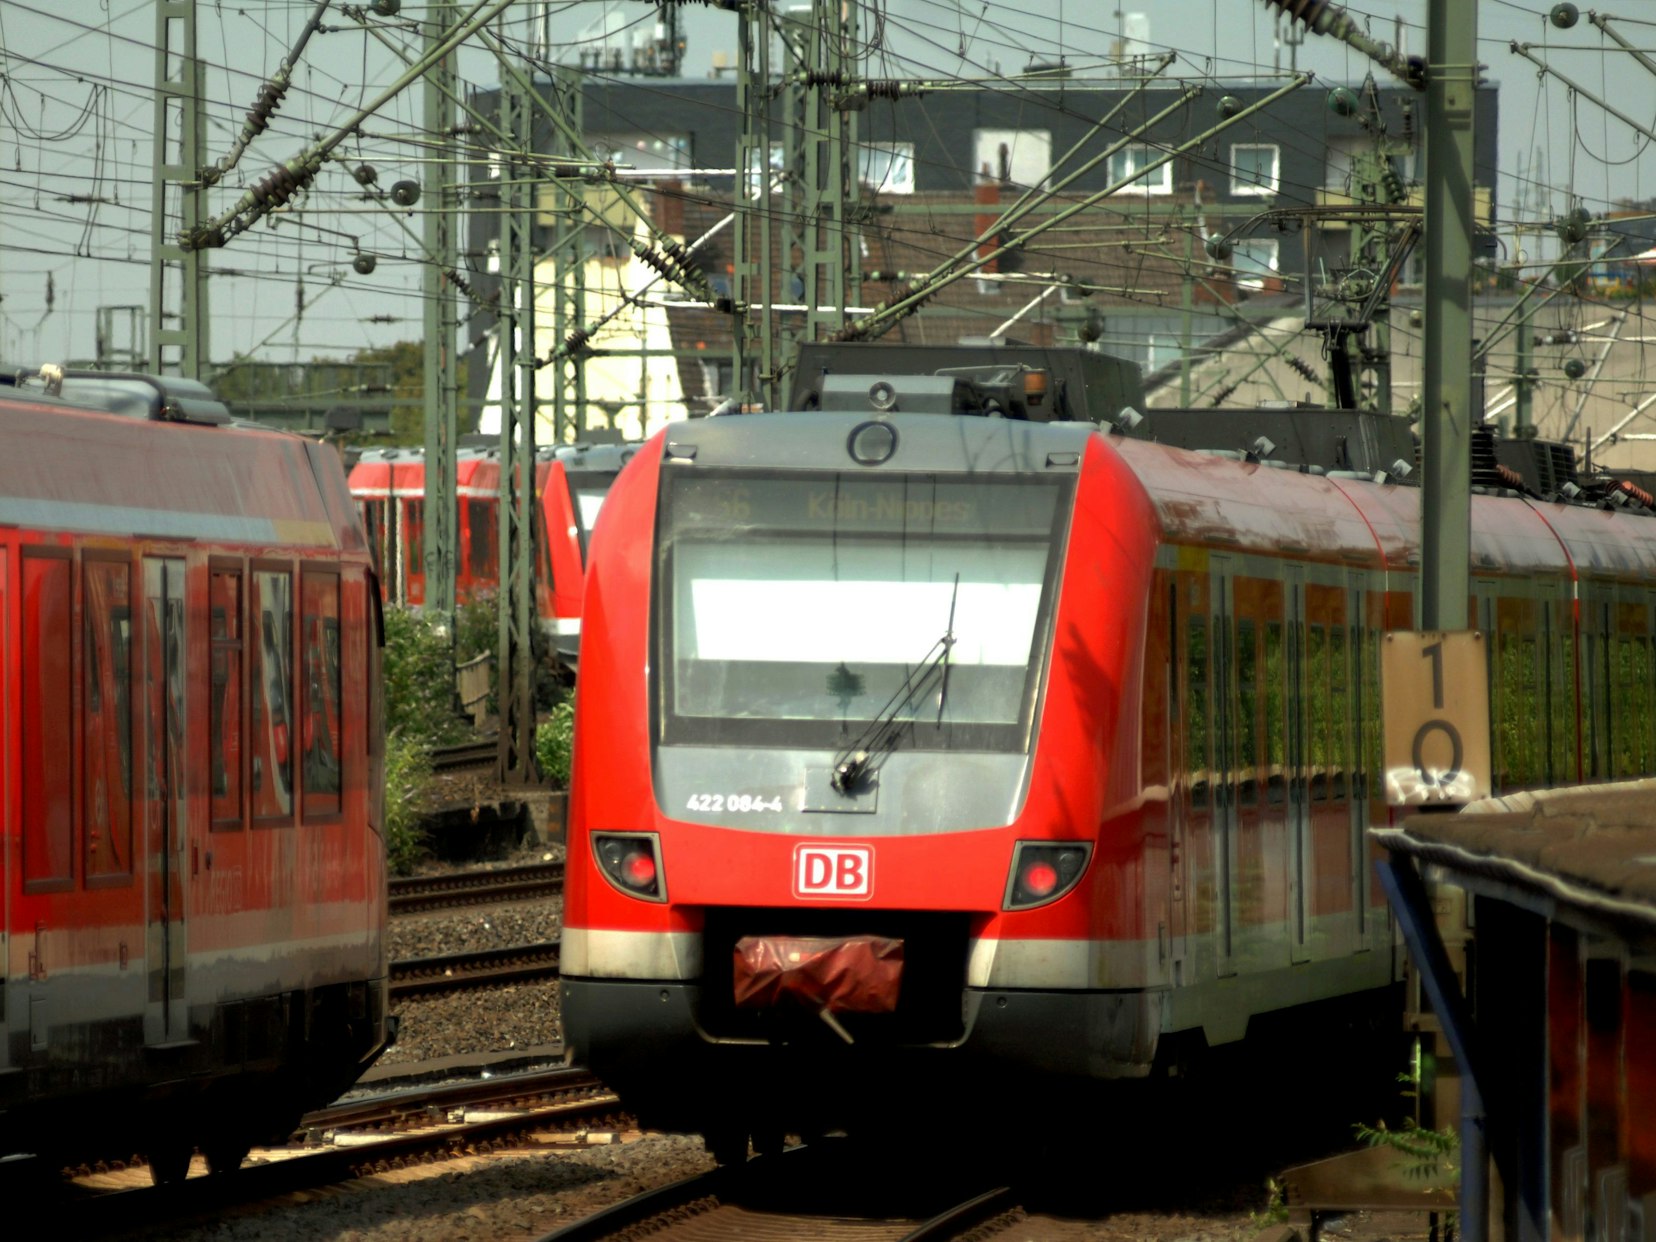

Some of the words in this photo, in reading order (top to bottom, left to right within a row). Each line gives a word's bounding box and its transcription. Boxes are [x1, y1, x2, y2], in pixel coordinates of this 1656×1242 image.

[686, 793, 724, 812] 422
[726, 794, 783, 812] 084-4
[803, 852, 865, 891] DB
